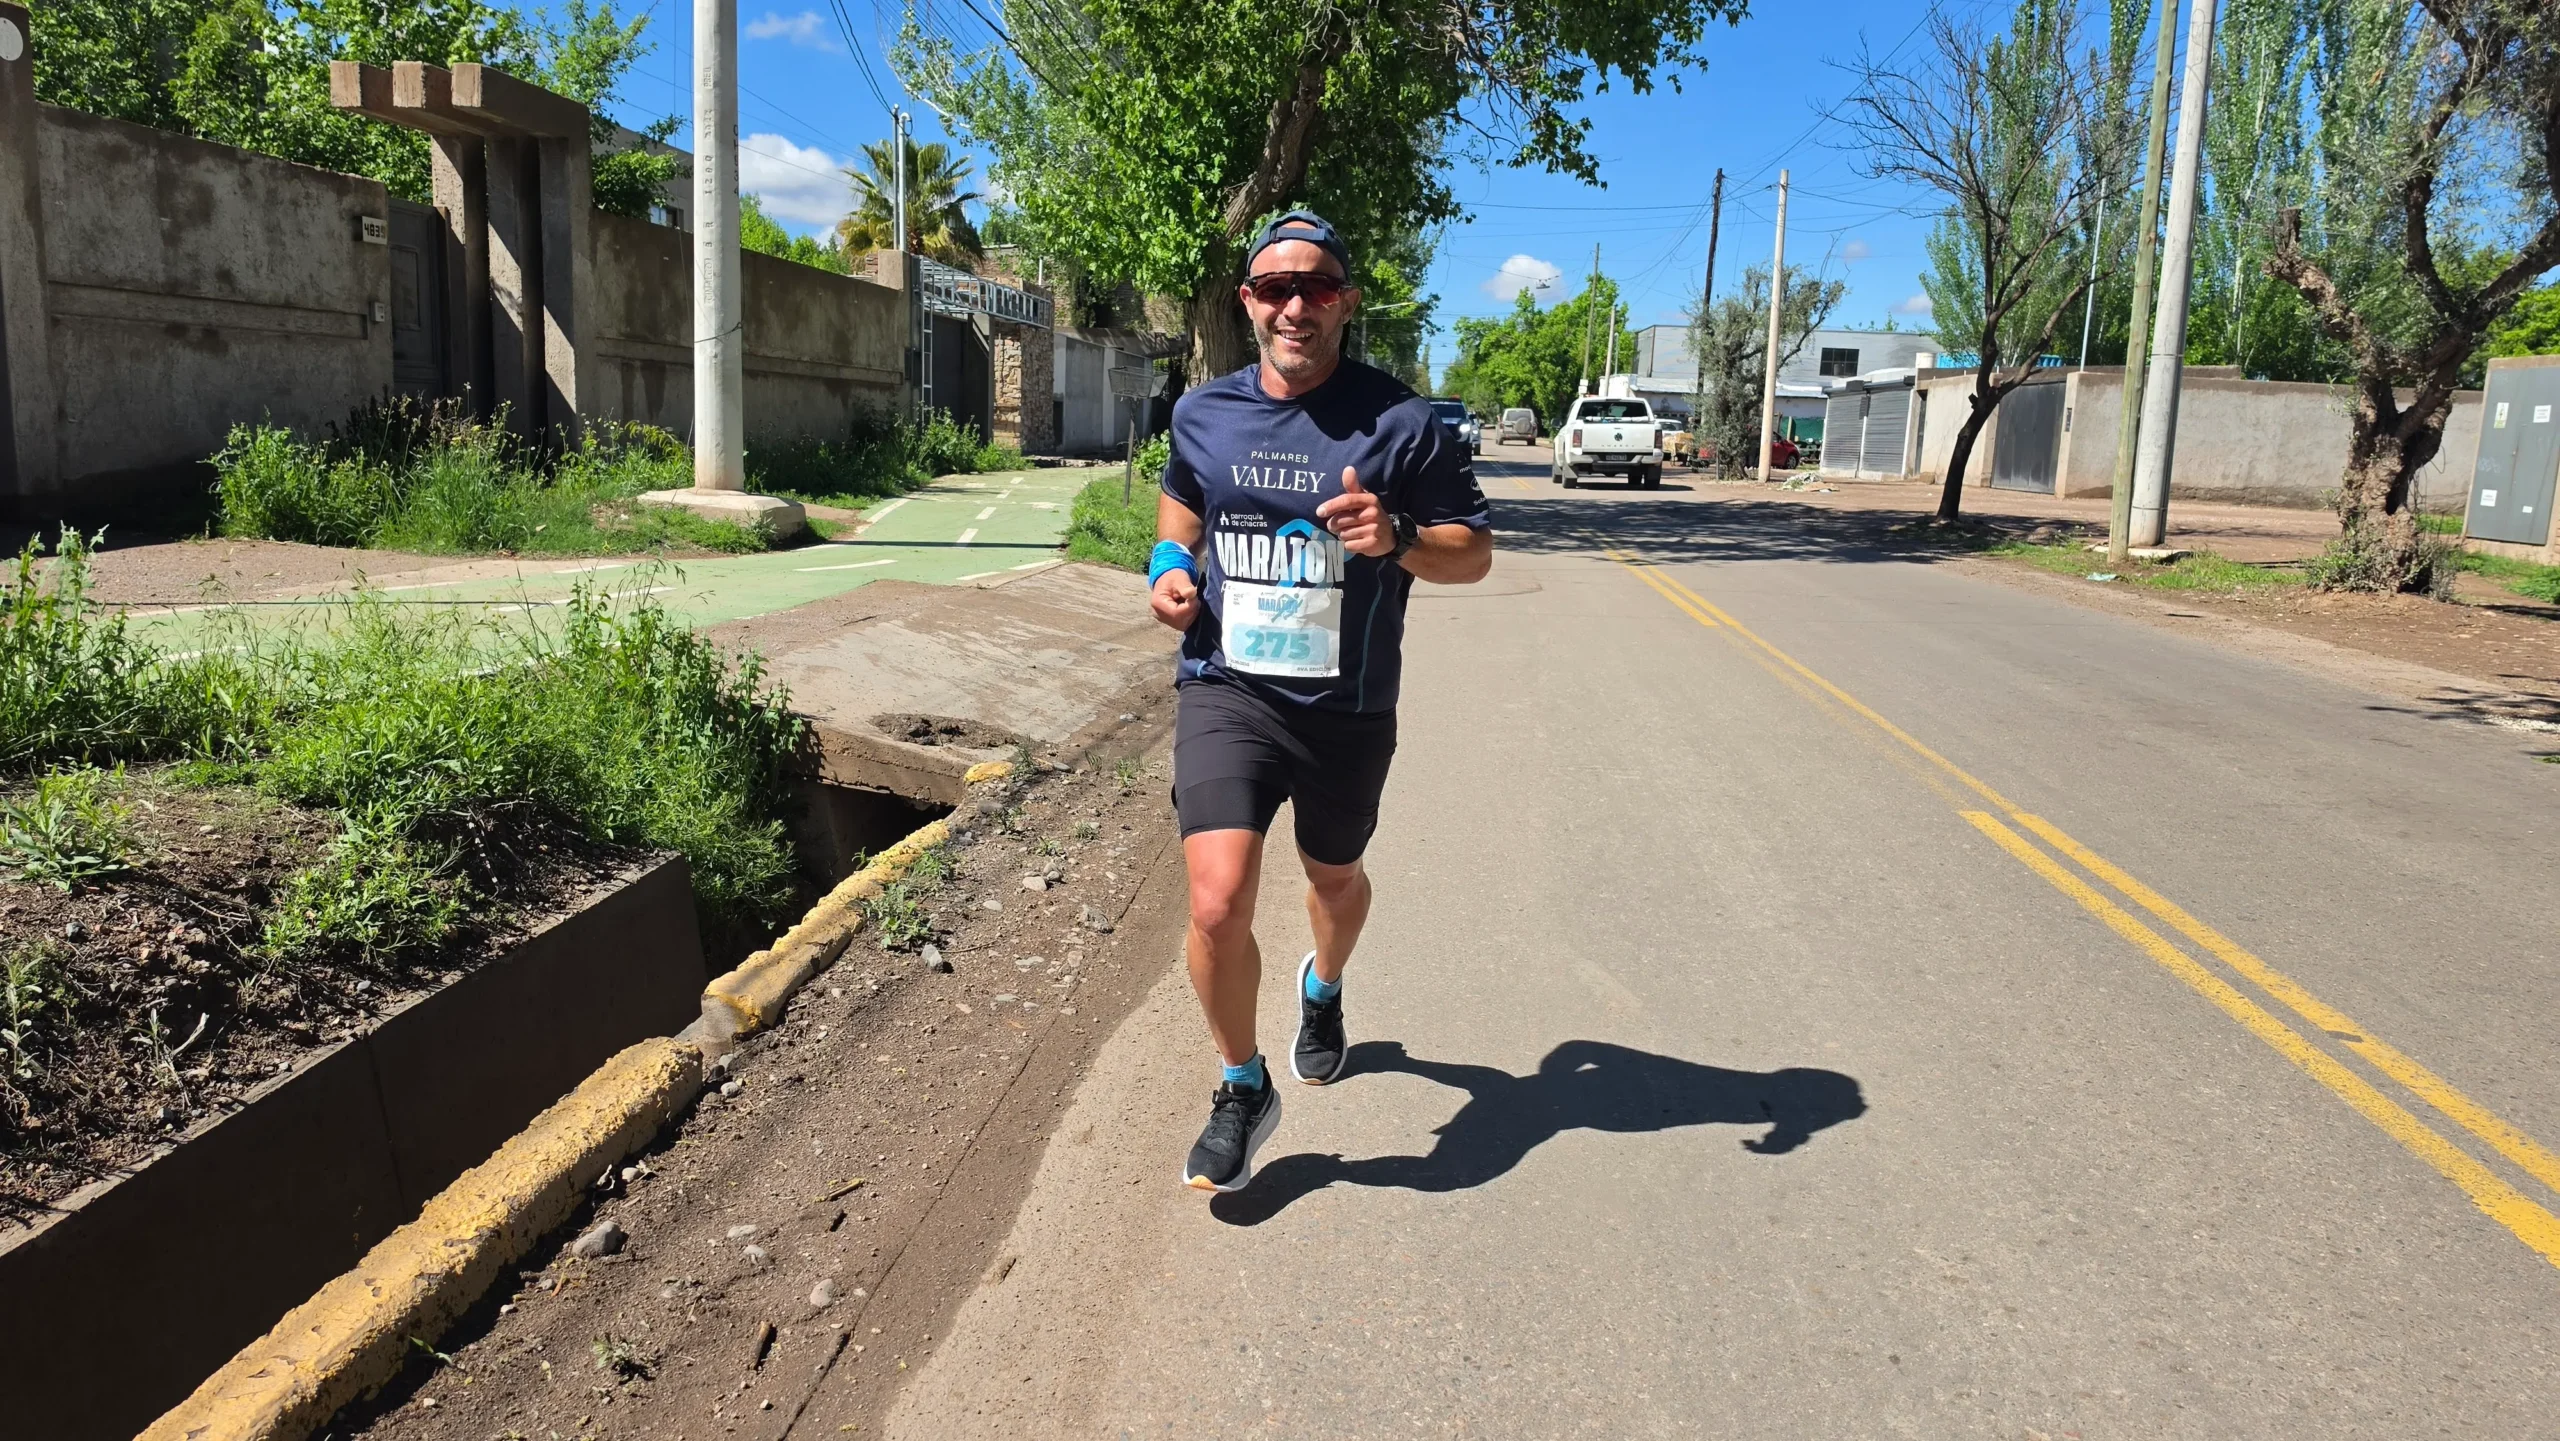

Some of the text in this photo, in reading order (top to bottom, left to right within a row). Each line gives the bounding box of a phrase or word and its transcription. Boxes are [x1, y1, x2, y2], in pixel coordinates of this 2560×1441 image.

[1250, 450, 1309, 464] PALMARES
[1230, 465, 1326, 493] VALLEY
[1230, 512, 1264, 521] parroquia
[1240, 520, 1268, 528] chacras
[1244, 629, 1311, 661] 275
